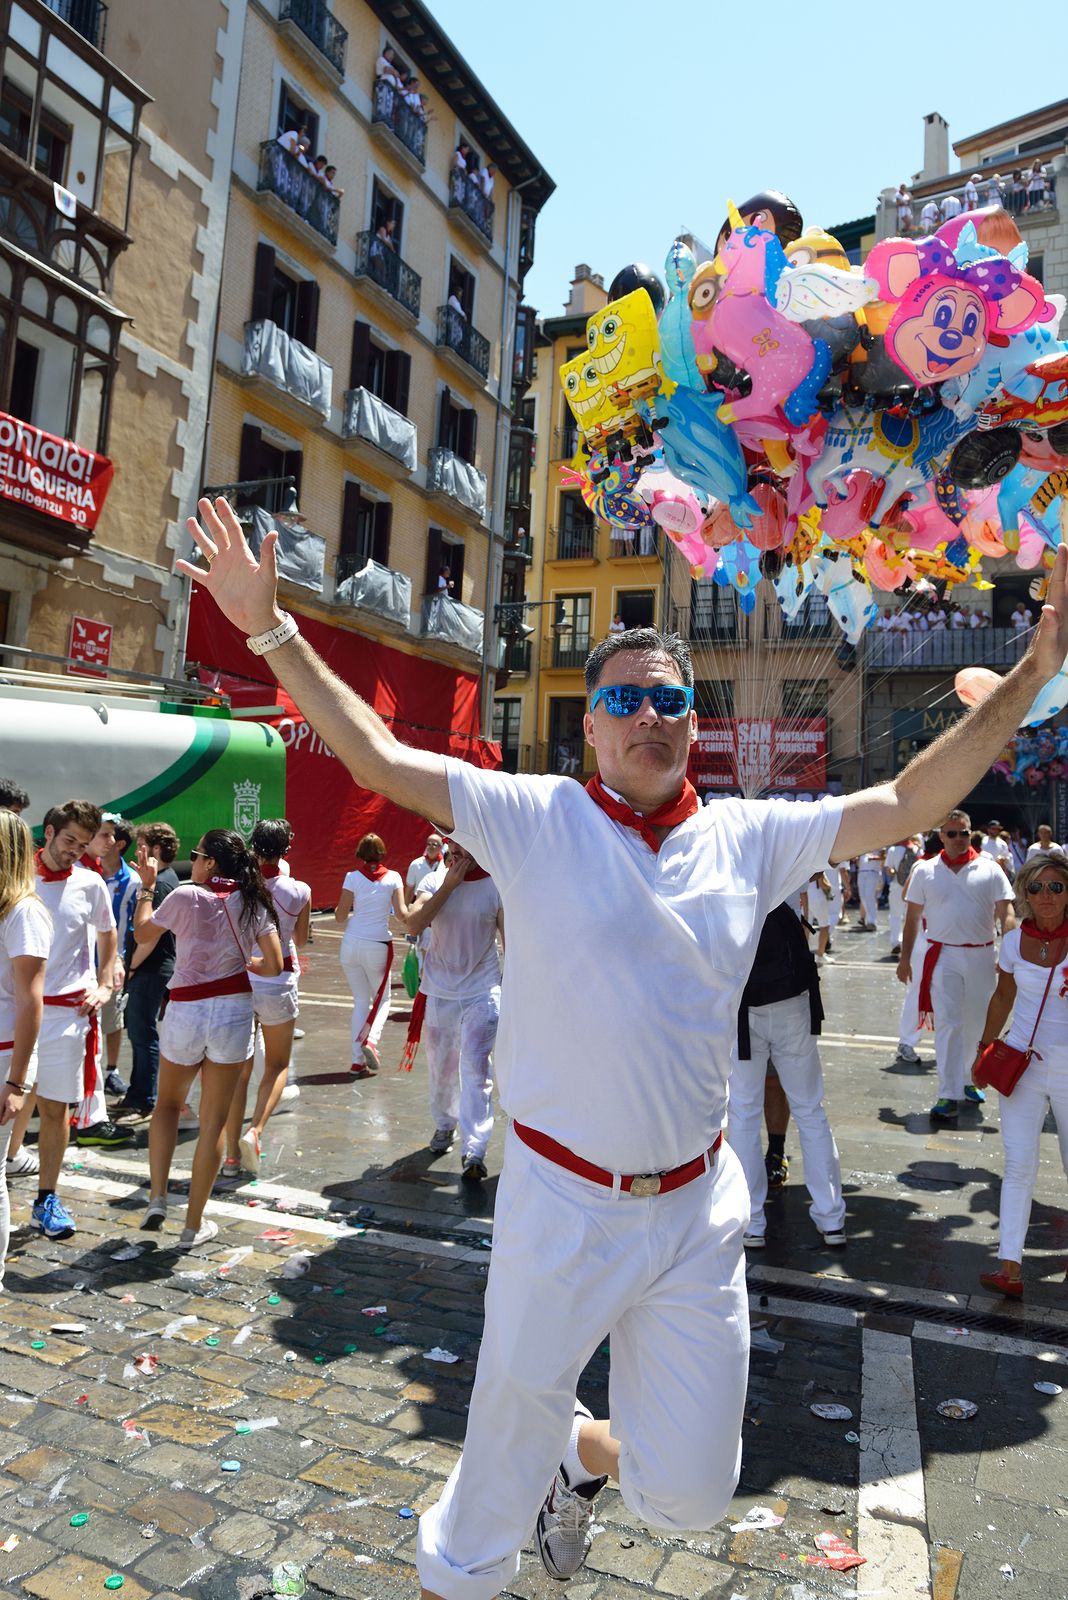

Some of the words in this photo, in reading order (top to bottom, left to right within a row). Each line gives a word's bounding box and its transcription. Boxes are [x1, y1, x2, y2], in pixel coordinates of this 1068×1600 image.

[70, 507, 86, 523] 30
[697, 730, 733, 741] AMISETAS
[738, 722, 772, 743] SAN
[775, 731, 824, 742] PANTALONES
[699, 742, 733, 752] T-SHIRTS
[776, 742, 817, 753] TROUSERS
[738, 744, 771, 764] FER
[697, 773, 733, 785] PAÑUELOS
